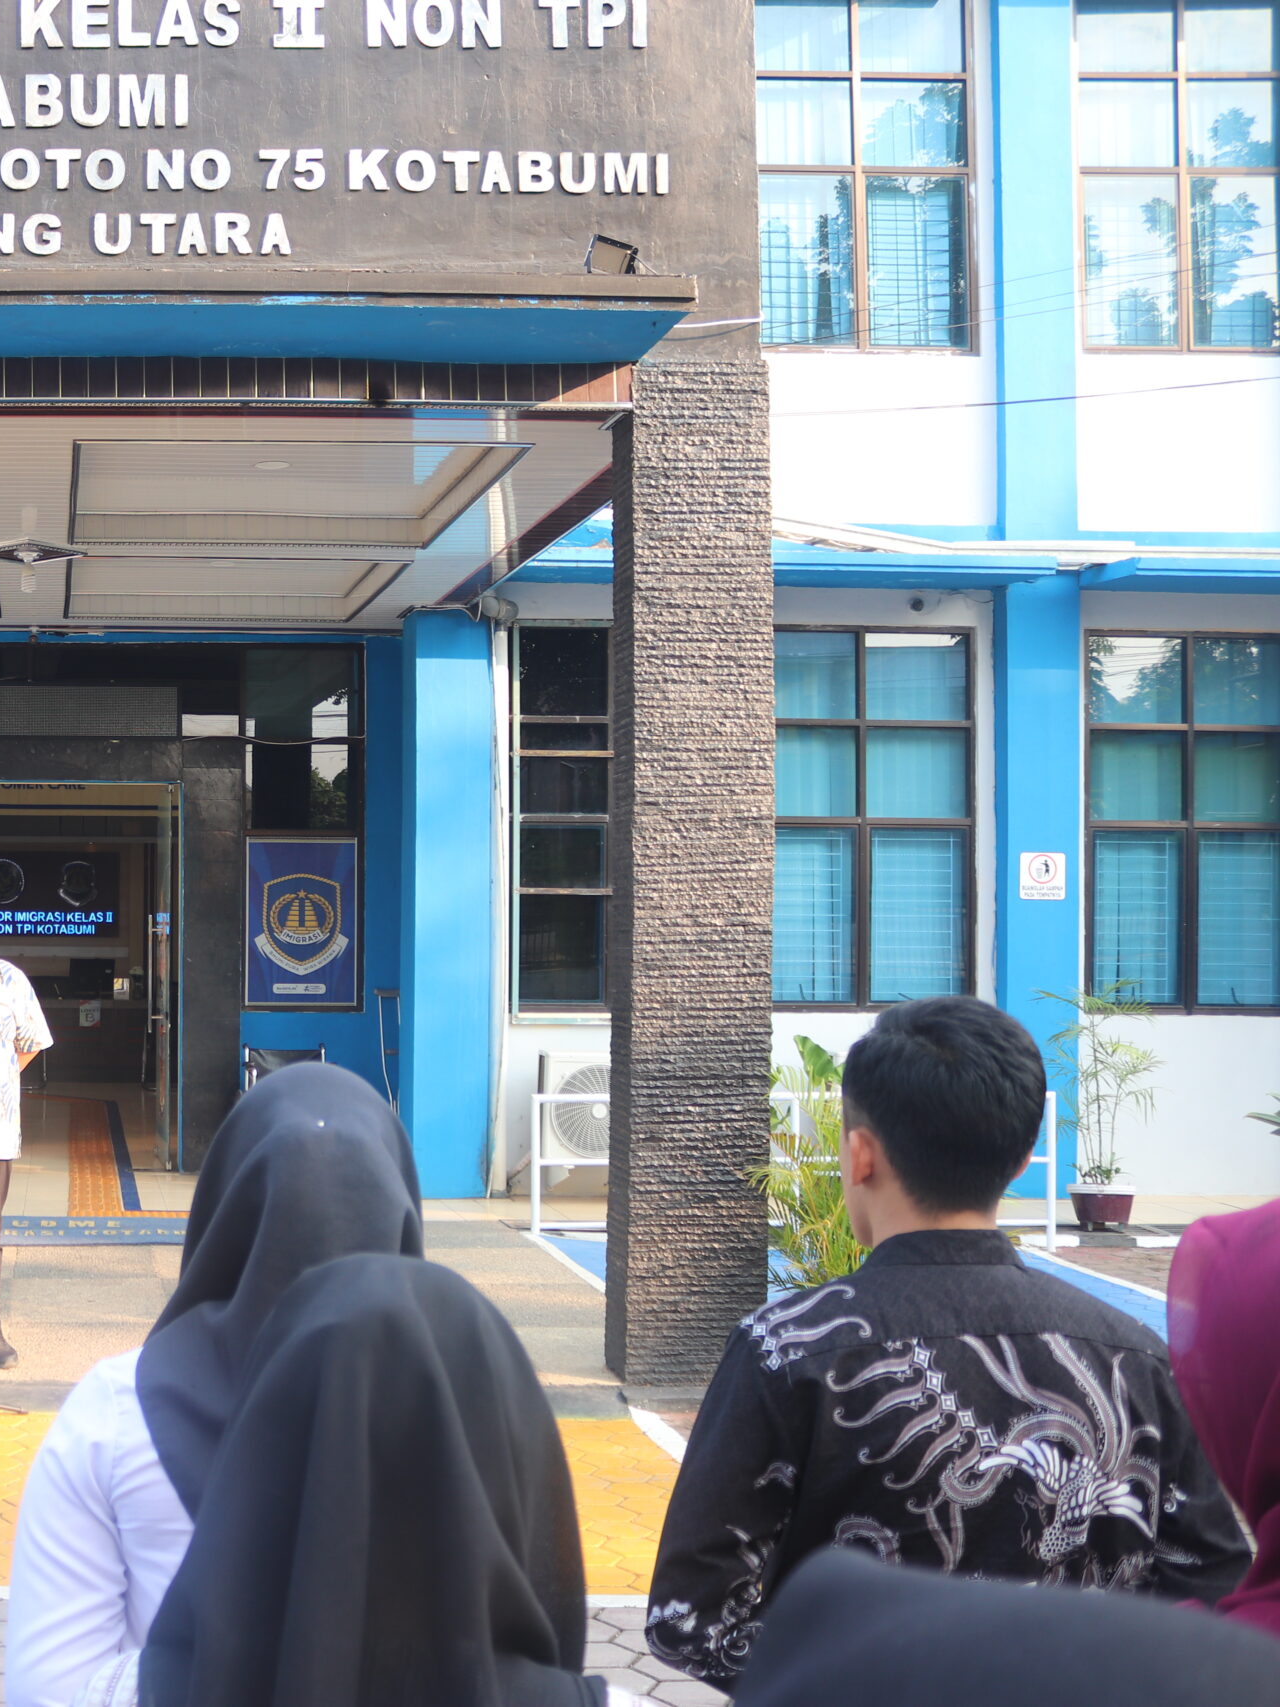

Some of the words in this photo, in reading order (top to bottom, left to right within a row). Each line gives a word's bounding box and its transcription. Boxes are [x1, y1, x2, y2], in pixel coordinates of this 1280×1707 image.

[20, 0, 246, 48] KELAS
[272, 0, 325, 48] II
[366, 0, 503, 48] NON
[538, 0, 648, 48] TPI
[146, 148, 232, 191] NO
[258, 148, 326, 191] 75
[348, 148, 669, 195] KOTABUMI
[93, 212, 293, 255] UTARA
[14, 911, 65, 923] IMIGRASI
[66, 911, 103, 923] KELAS
[106, 911, 113, 923] II
[17, 923, 34, 935] TPI
[36, 923, 95, 935] KOTABUMI
[282, 930, 322, 944] IMIGRASI
[11, 1220, 121, 1228] COME
